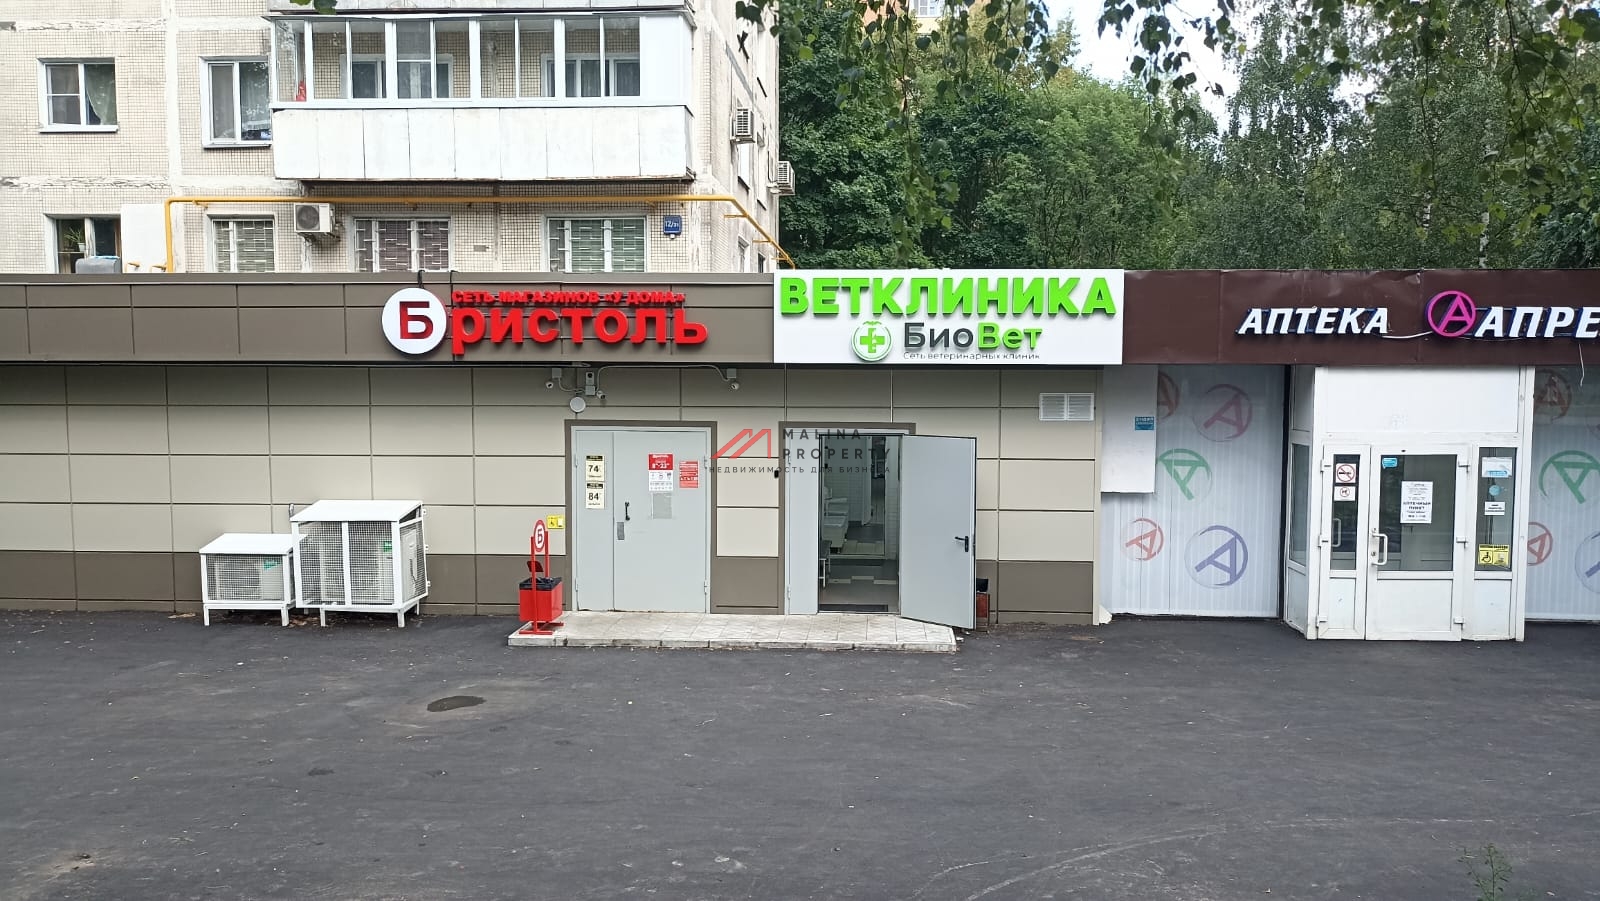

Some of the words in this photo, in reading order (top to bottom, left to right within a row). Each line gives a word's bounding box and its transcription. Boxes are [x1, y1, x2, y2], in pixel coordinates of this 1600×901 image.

[452, 290, 495, 303] СЕТЬ
[498, 290, 600, 303] МАГАЗИНОВ
[780, 277, 1116, 317] ВЕТКЛИНИКА
[1236, 307, 1389, 335] АПТЕКА
[1473, 306, 1600, 338] АПРЕ
[903, 322, 1043, 350] БиоВет
[903, 351, 926, 360] Сеть
[928, 351, 1000, 361] ветеринарных
[1003, 352, 1040, 360] клиник
